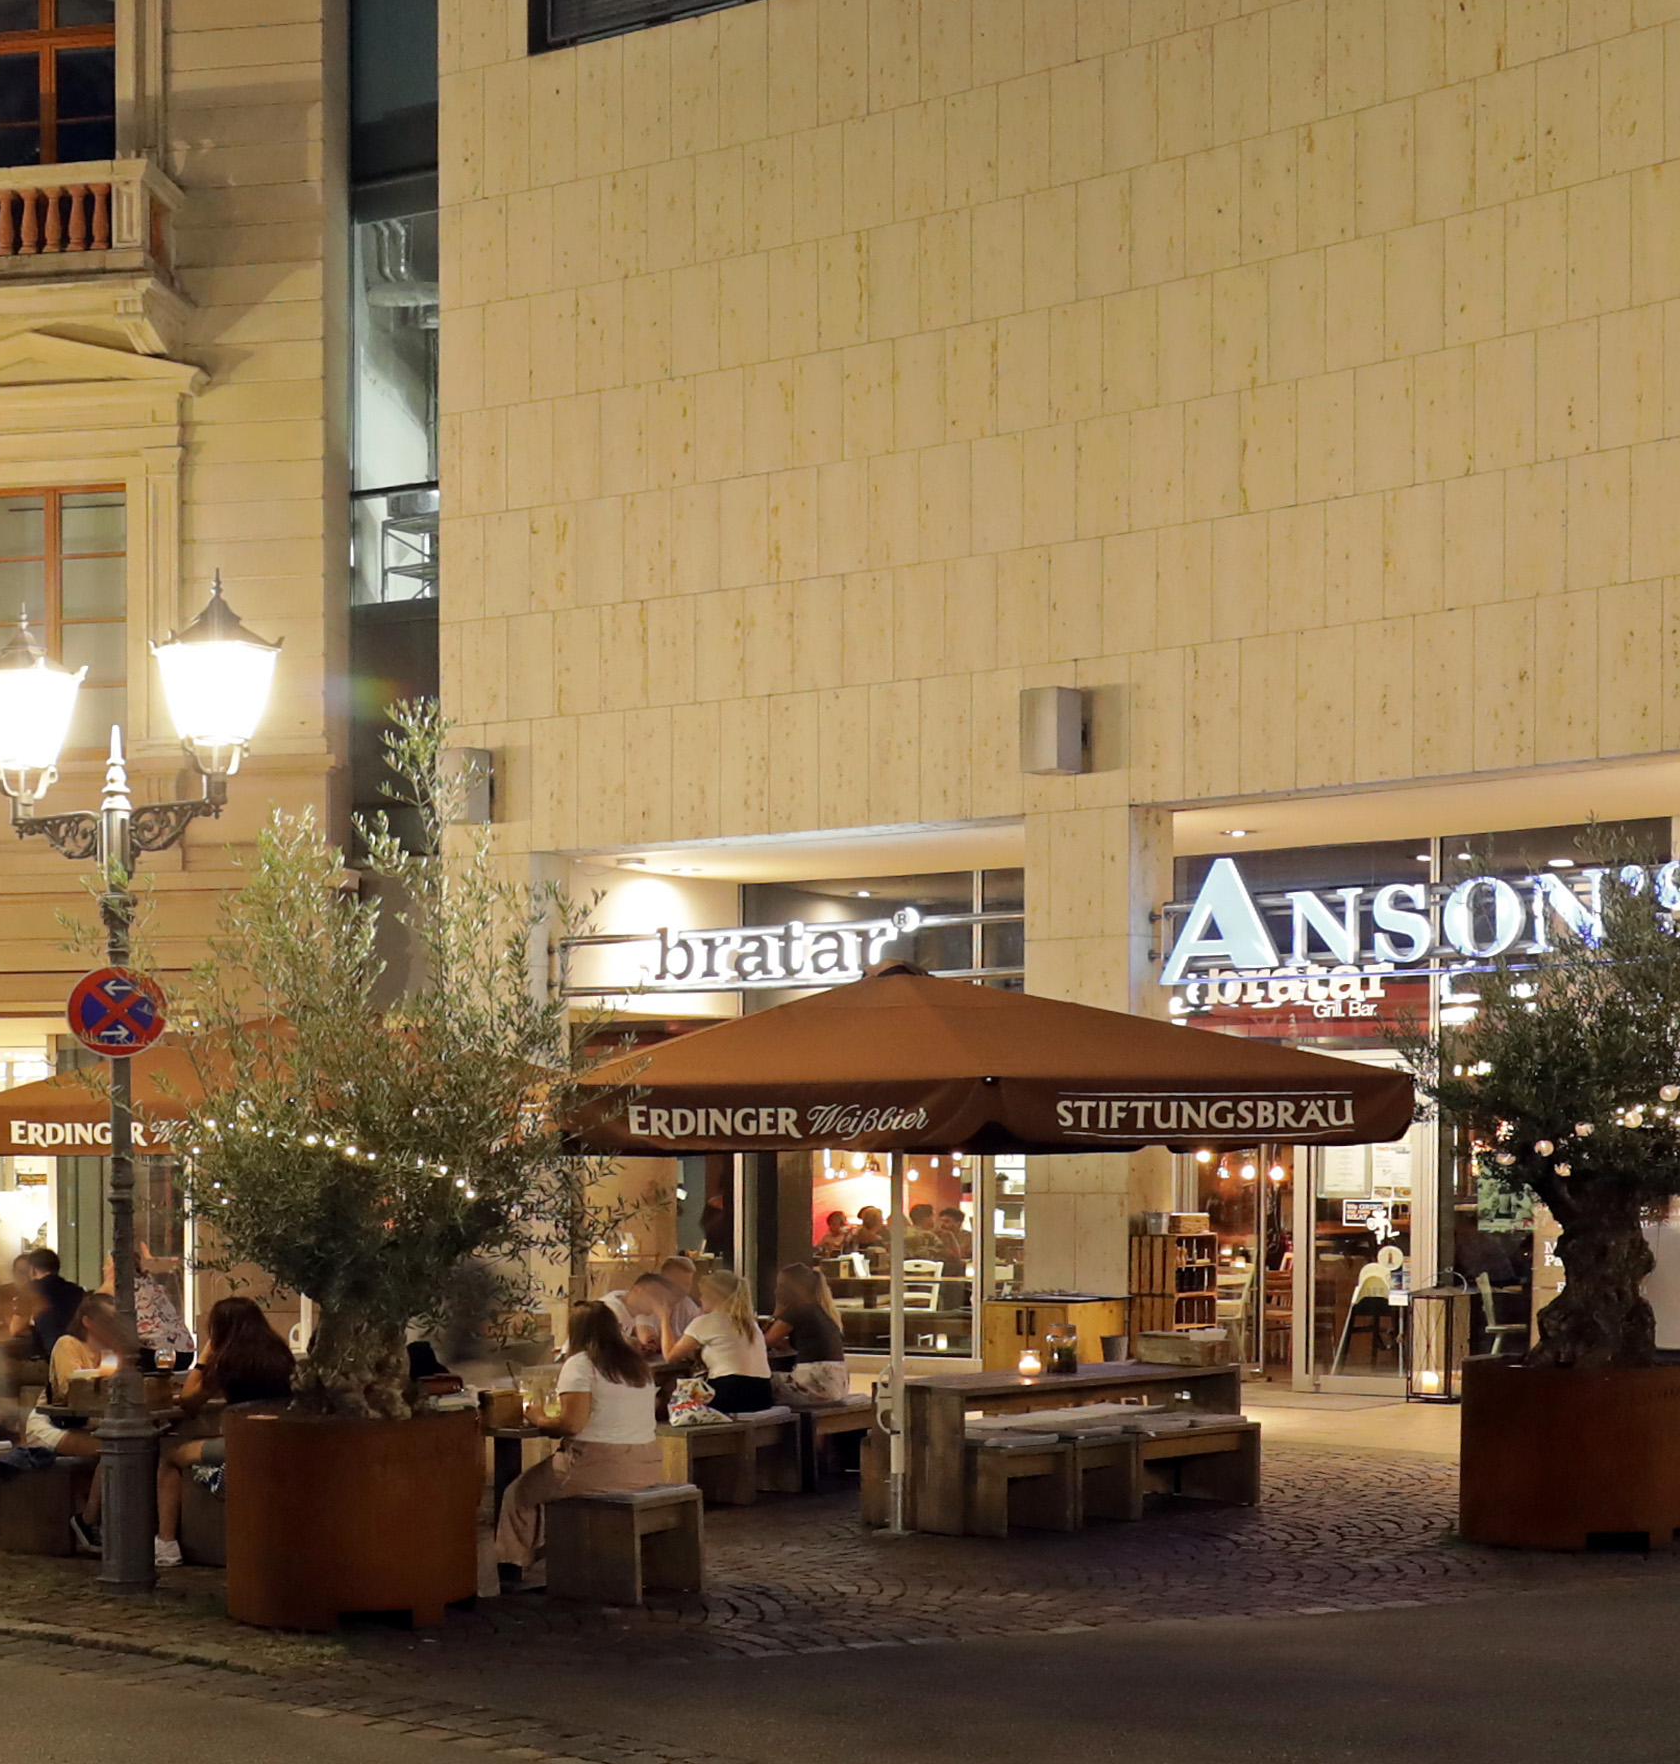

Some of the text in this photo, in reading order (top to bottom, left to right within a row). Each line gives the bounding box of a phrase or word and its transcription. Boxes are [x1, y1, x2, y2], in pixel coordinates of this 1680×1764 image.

[627, 1103, 930, 1141] ERDINGER Weißbier
[1055, 1098, 1356, 1130] STIFTUNGSBRÄU
[10, 1120, 149, 1148] ERDINGR
